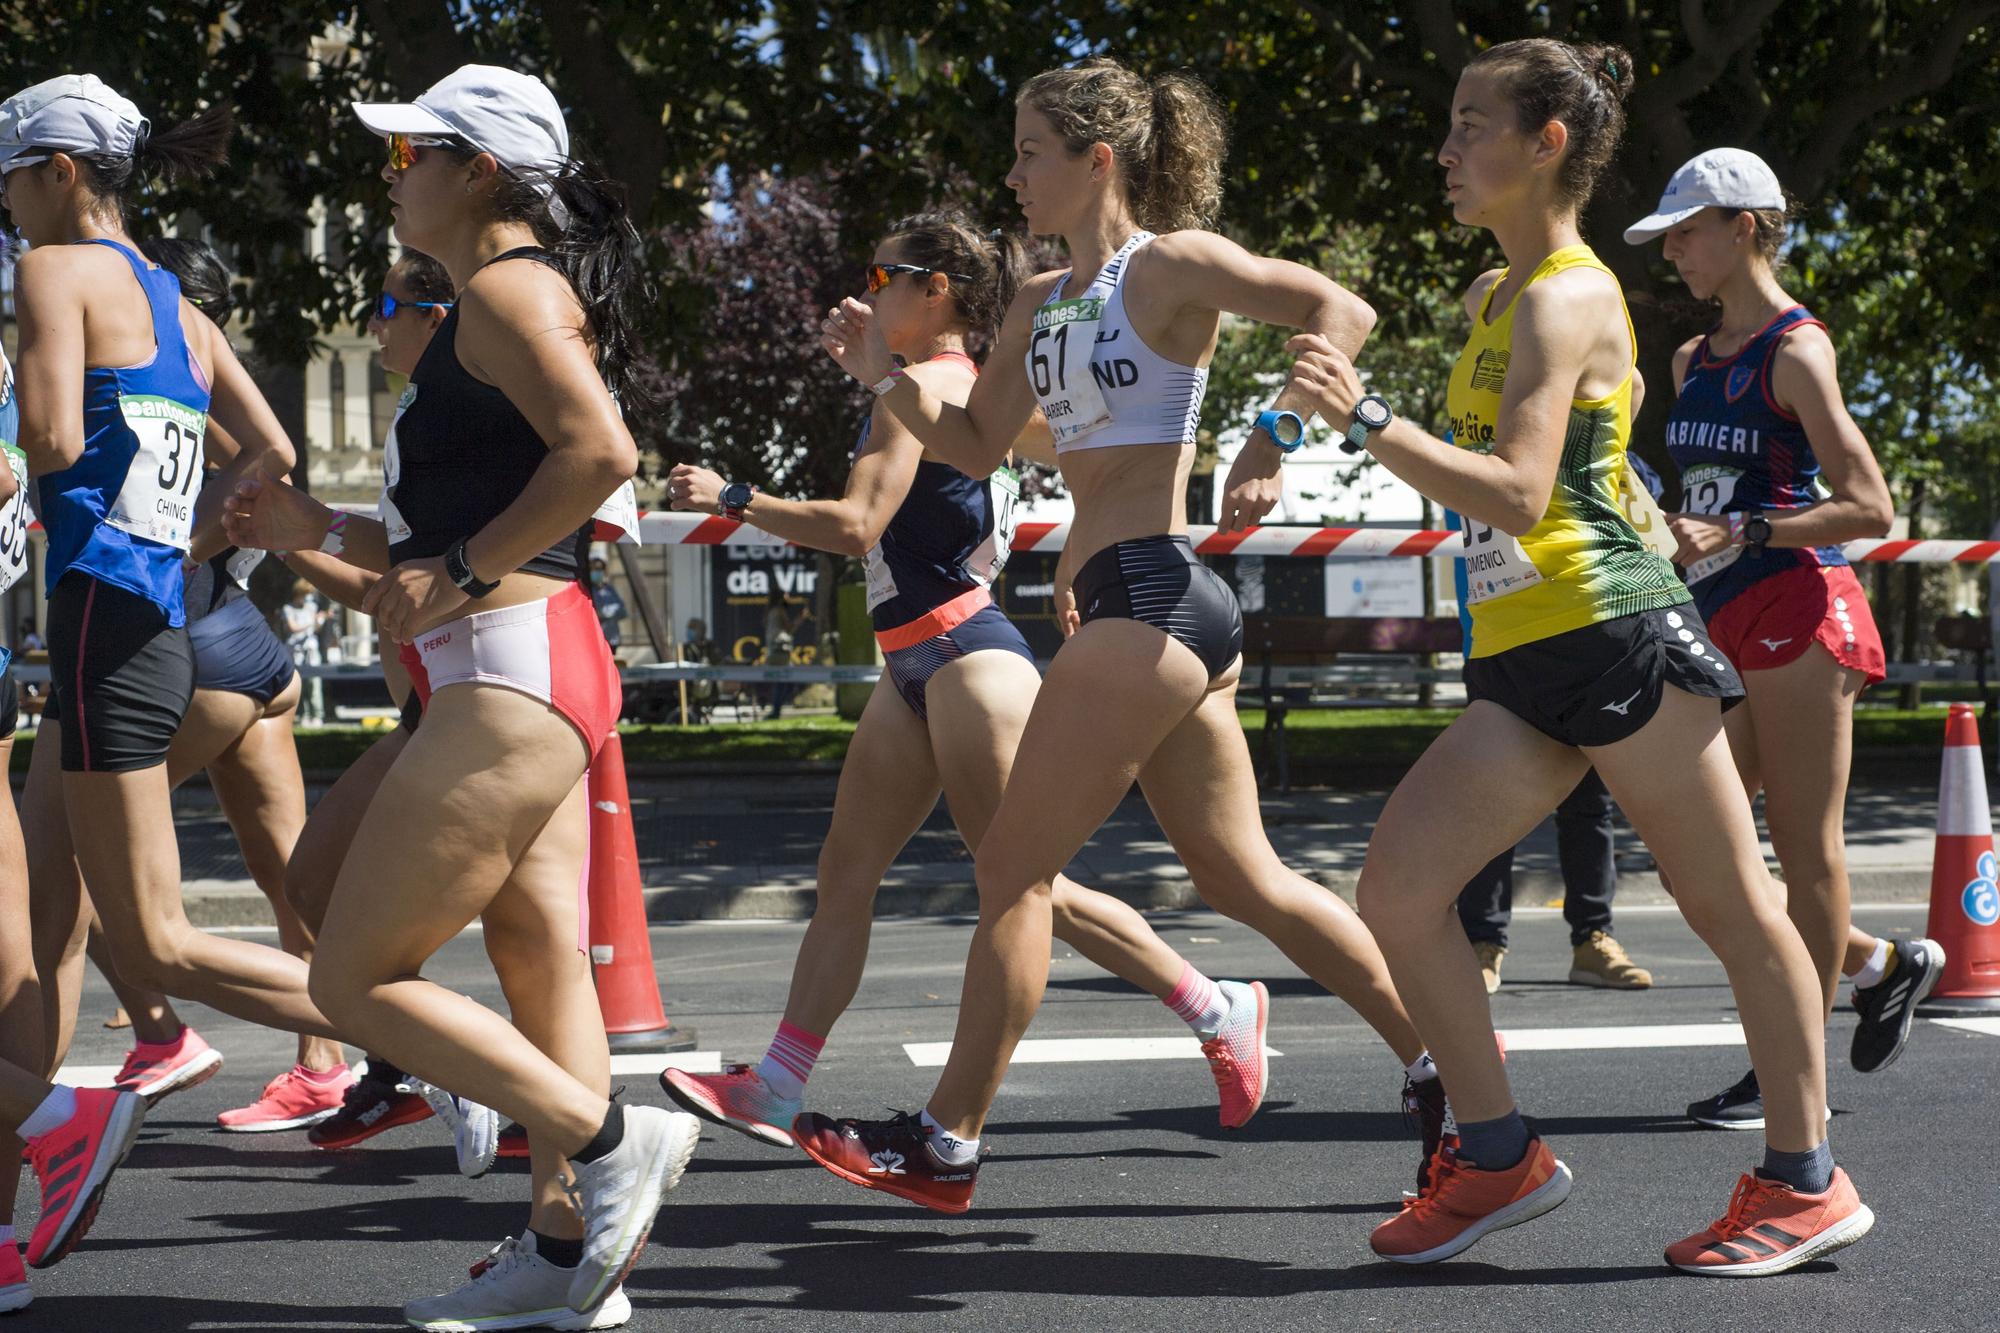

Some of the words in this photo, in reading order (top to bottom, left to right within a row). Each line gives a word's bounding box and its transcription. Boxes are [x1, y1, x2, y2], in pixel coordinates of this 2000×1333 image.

[1031, 323, 1069, 397] 61
[1091, 358, 1139, 390] ND
[158, 421, 198, 496] 37
[156, 498, 187, 522] CHING
[1466, 549, 1506, 575] OMENICI
[726, 564, 769, 594] da
[423, 631, 452, 653] PERU
